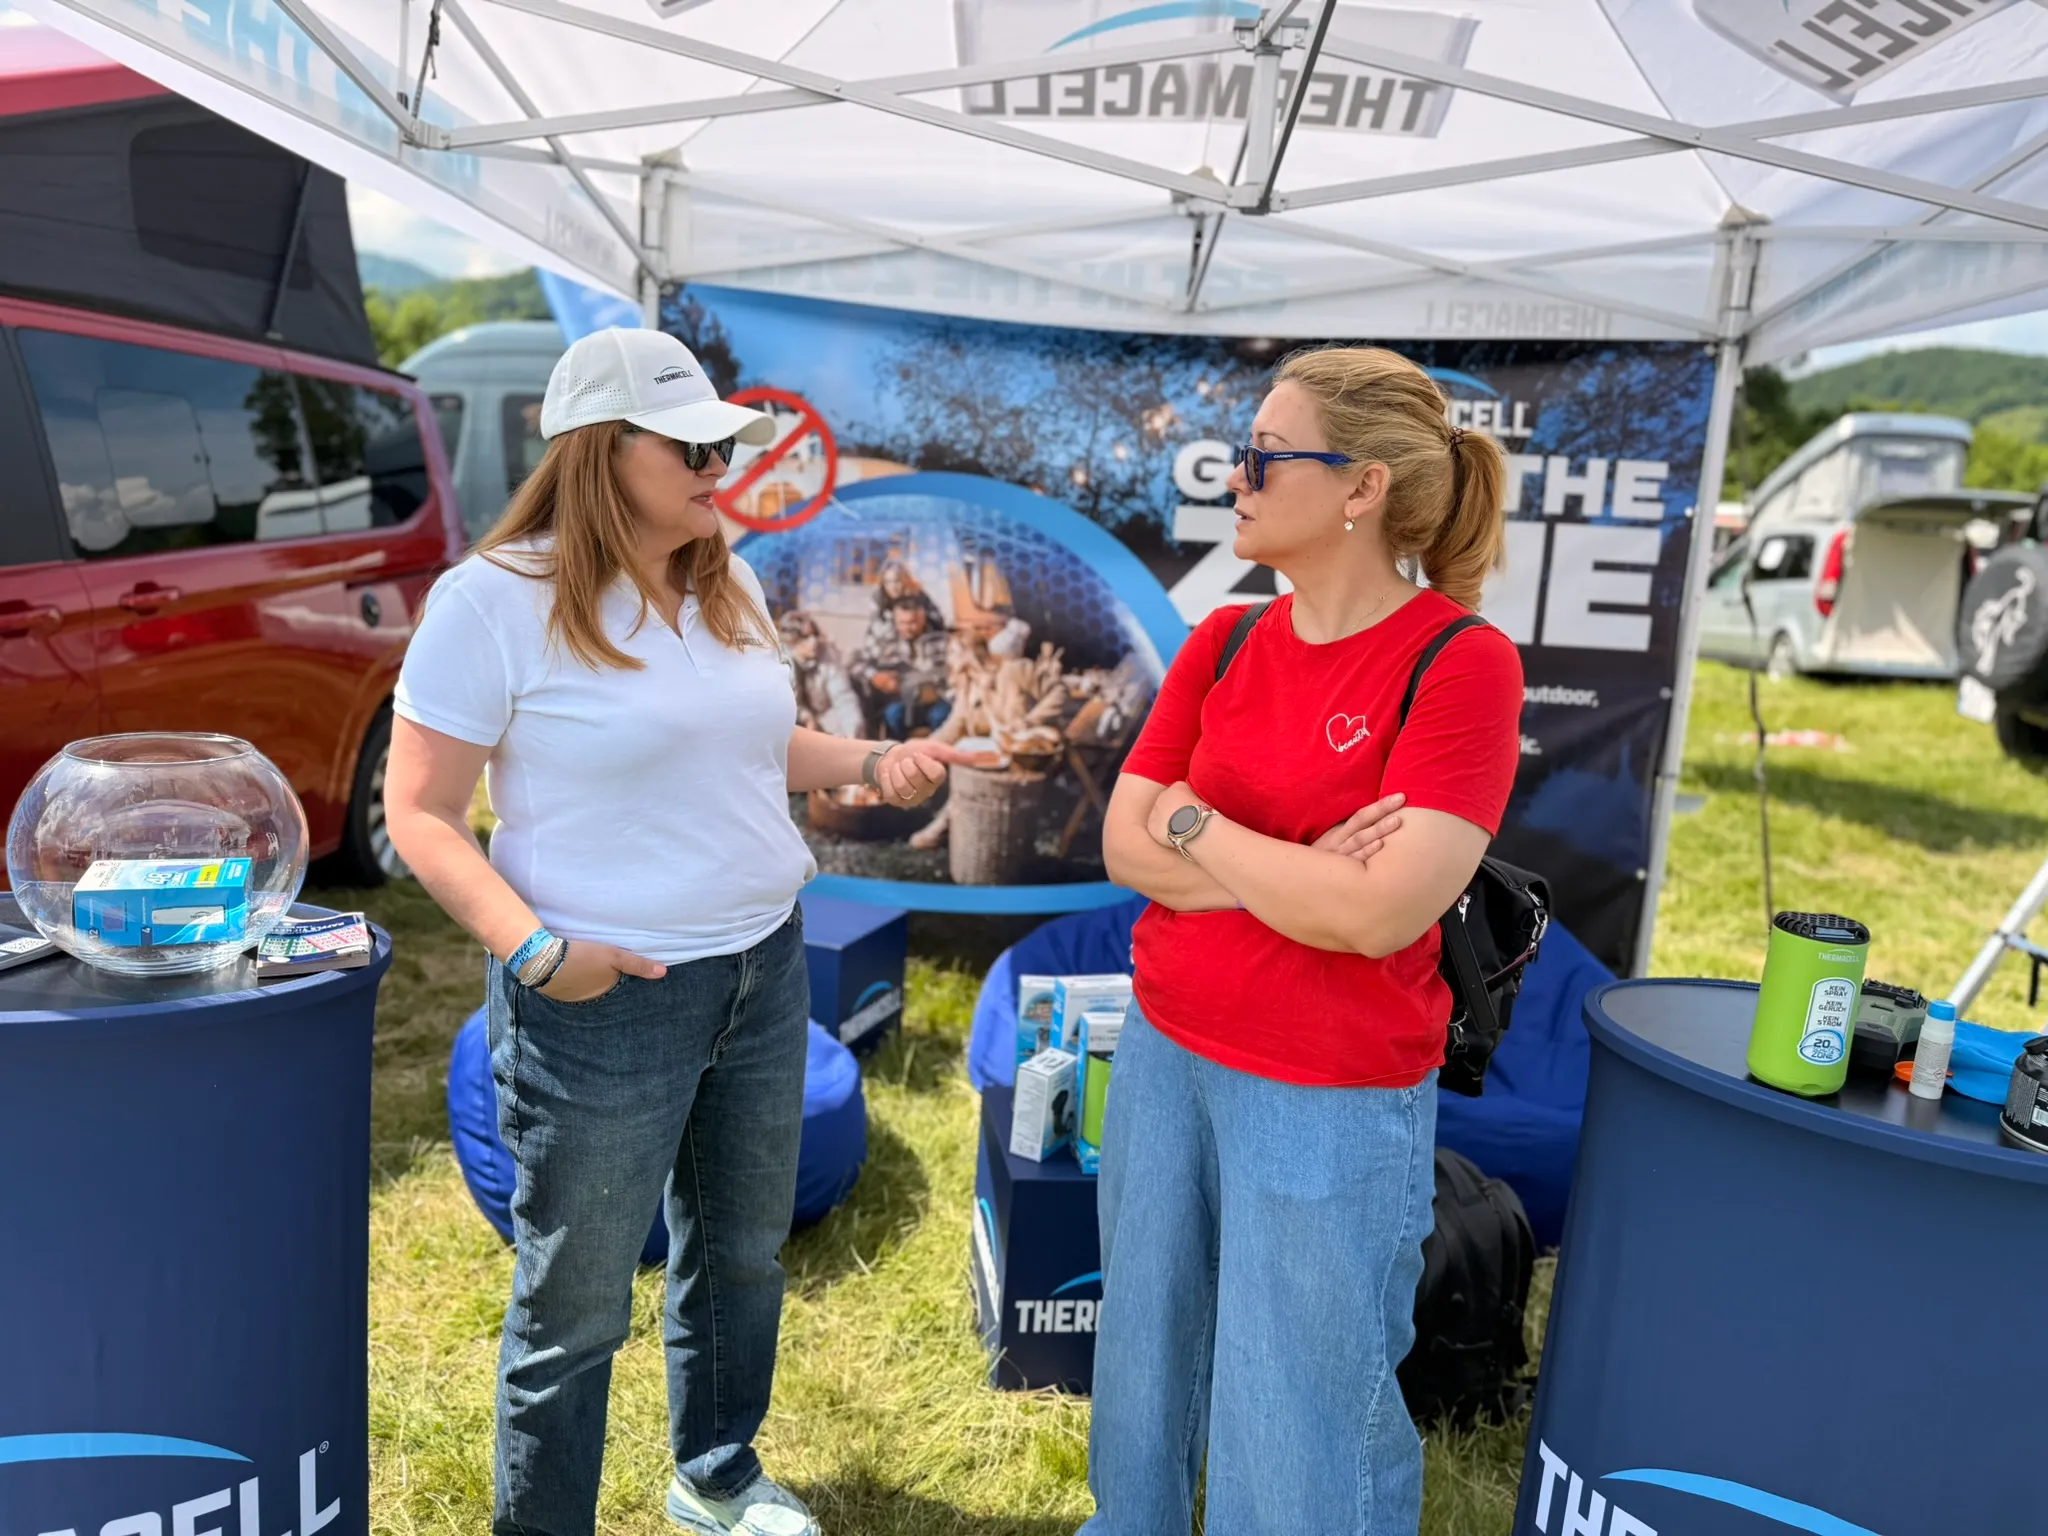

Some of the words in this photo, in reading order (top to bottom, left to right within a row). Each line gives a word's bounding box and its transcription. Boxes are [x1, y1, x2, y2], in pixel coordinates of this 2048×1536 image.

[654, 370, 694, 385] THERMACELL
[1450, 400, 1533, 438] CELL
[1501, 454, 1669, 520] THE
[1168, 506, 1662, 652] ZE
[1818, 953, 1859, 962] THERMACELL
[1814, 1038, 1831, 1048] 20
